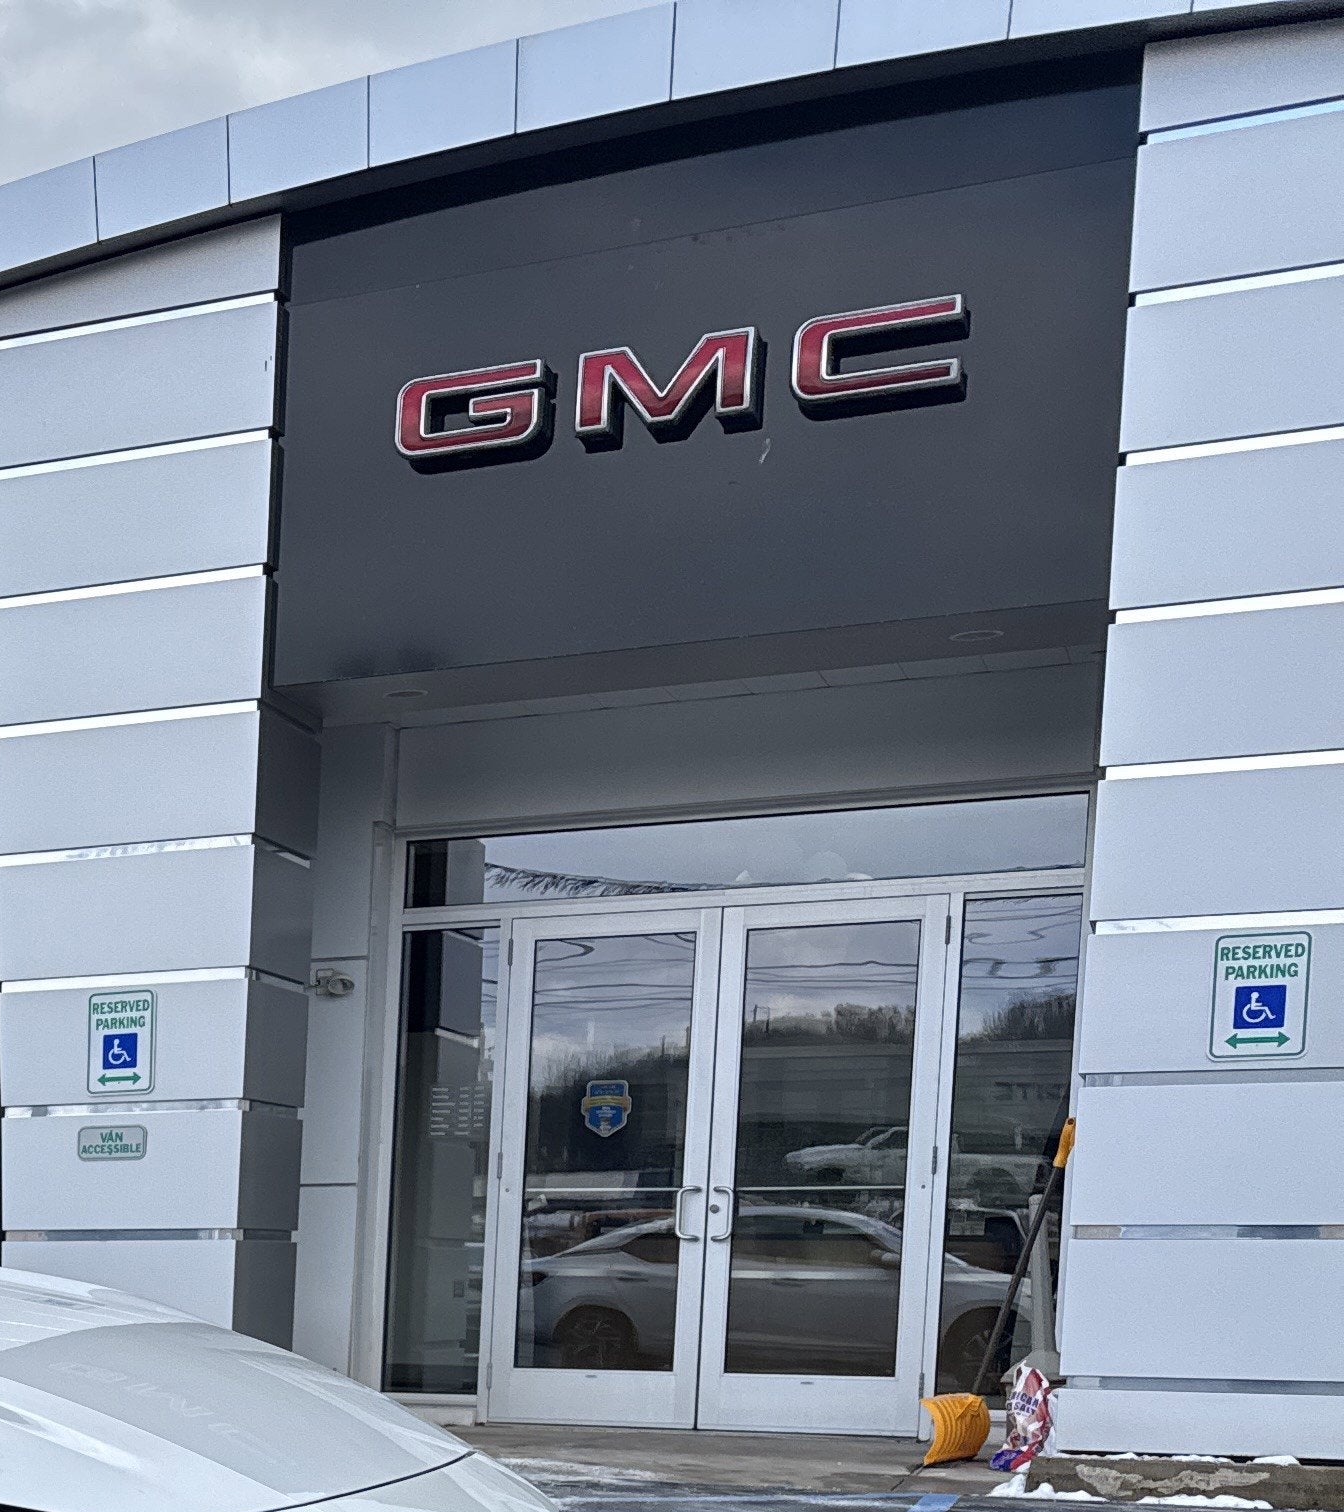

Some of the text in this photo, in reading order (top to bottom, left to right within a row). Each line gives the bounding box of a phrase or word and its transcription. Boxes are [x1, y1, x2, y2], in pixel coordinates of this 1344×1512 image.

[395, 294, 968, 472] GMC
[1220, 942, 1306, 961] RESERVED
[1224, 963, 1299, 980] PARKING
[92, 999, 150, 1015] RESERVED
[96, 1016, 146, 1031] PARKING
[100, 1130, 124, 1144] VAN
[81, 1143, 142, 1155] ACCESSIBLE
